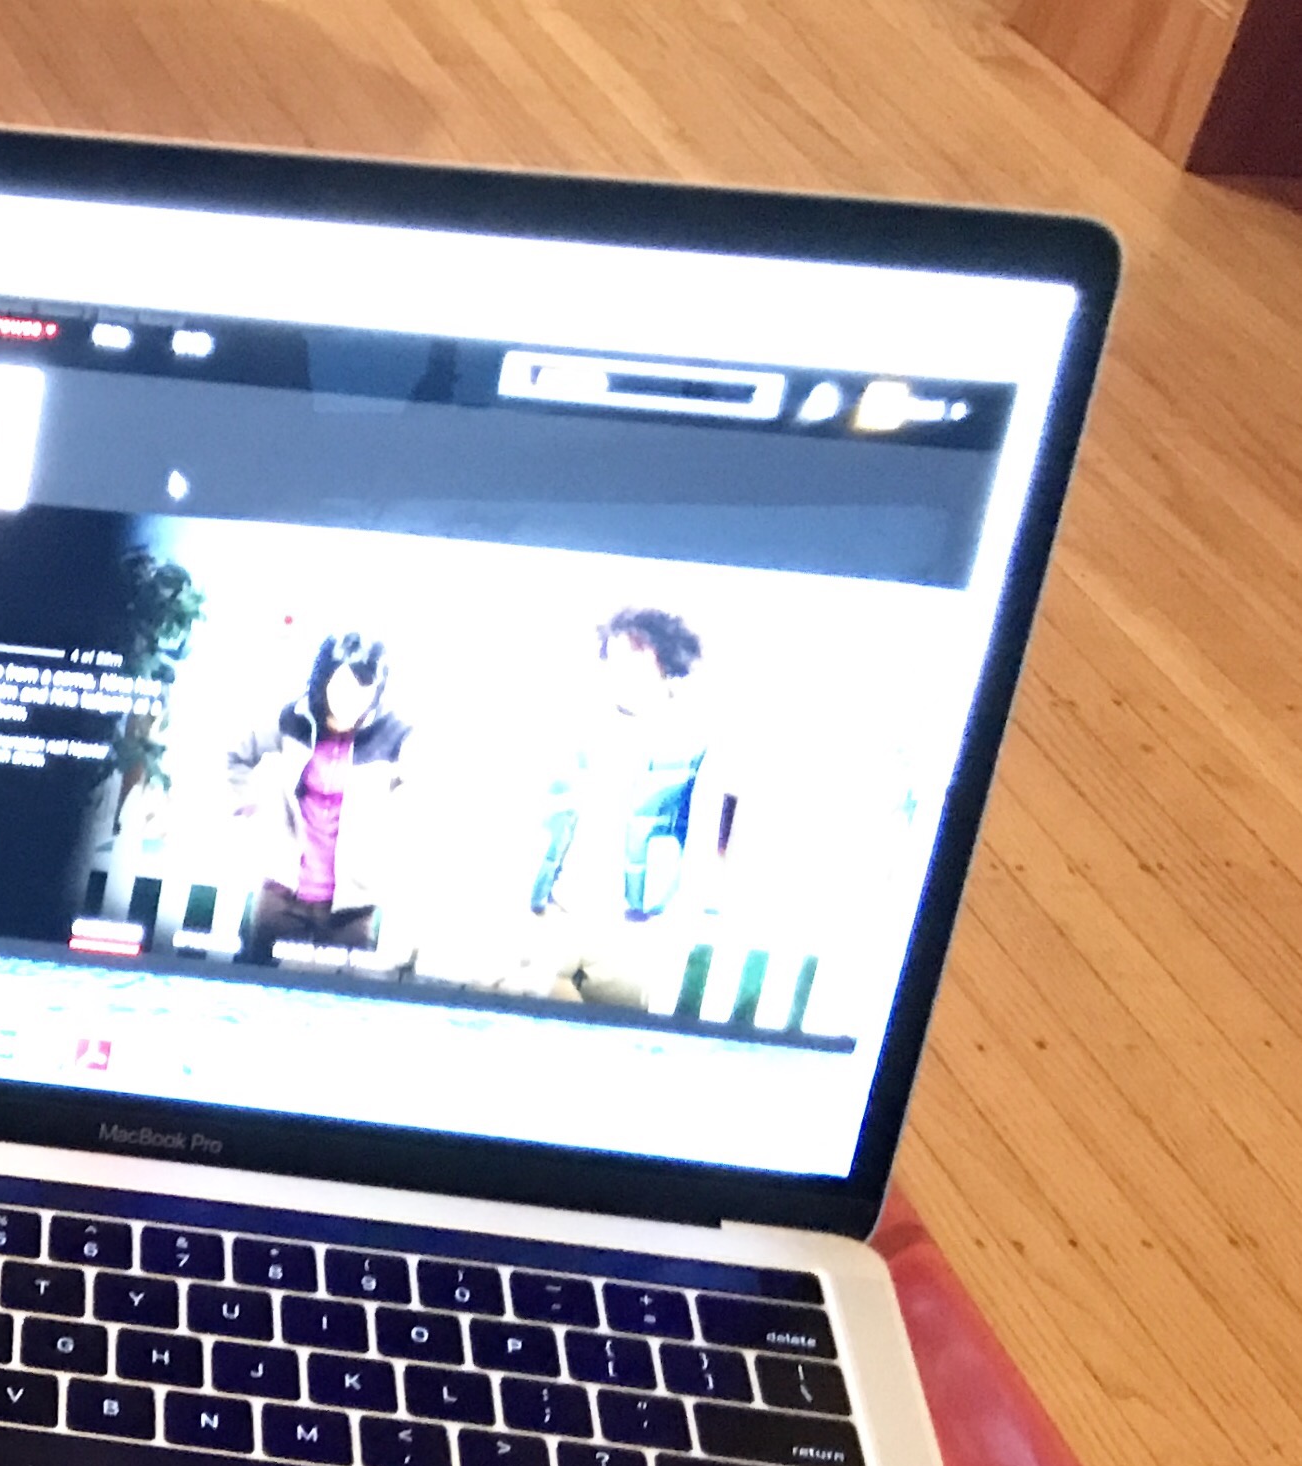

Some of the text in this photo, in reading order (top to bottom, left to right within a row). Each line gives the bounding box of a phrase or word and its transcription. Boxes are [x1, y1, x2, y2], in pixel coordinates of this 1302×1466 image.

[99, 1122, 223, 1155] MacBook Pro
[36, 1279, 50, 1295] T
[129, 1291, 145, 1307] Y
[222, 1302, 240, 1319] U
[56, 1337, 74, 1353] G
[506, 1337, 523, 1353] P
[766, 1331, 817, 1348] delete
[151, 1349, 170, 1365] H
[250, 1362, 264, 1378] J
[344, 1373, 361, 1390] K
[6, 1386, 24, 1403] V
[442, 1386, 457, 1402] L
[103, 1398, 120, 1416] B
[200, 1412, 219, 1429] N
[296, 1424, 319, 1442] M
[792, 1446, 845, 1462] return
